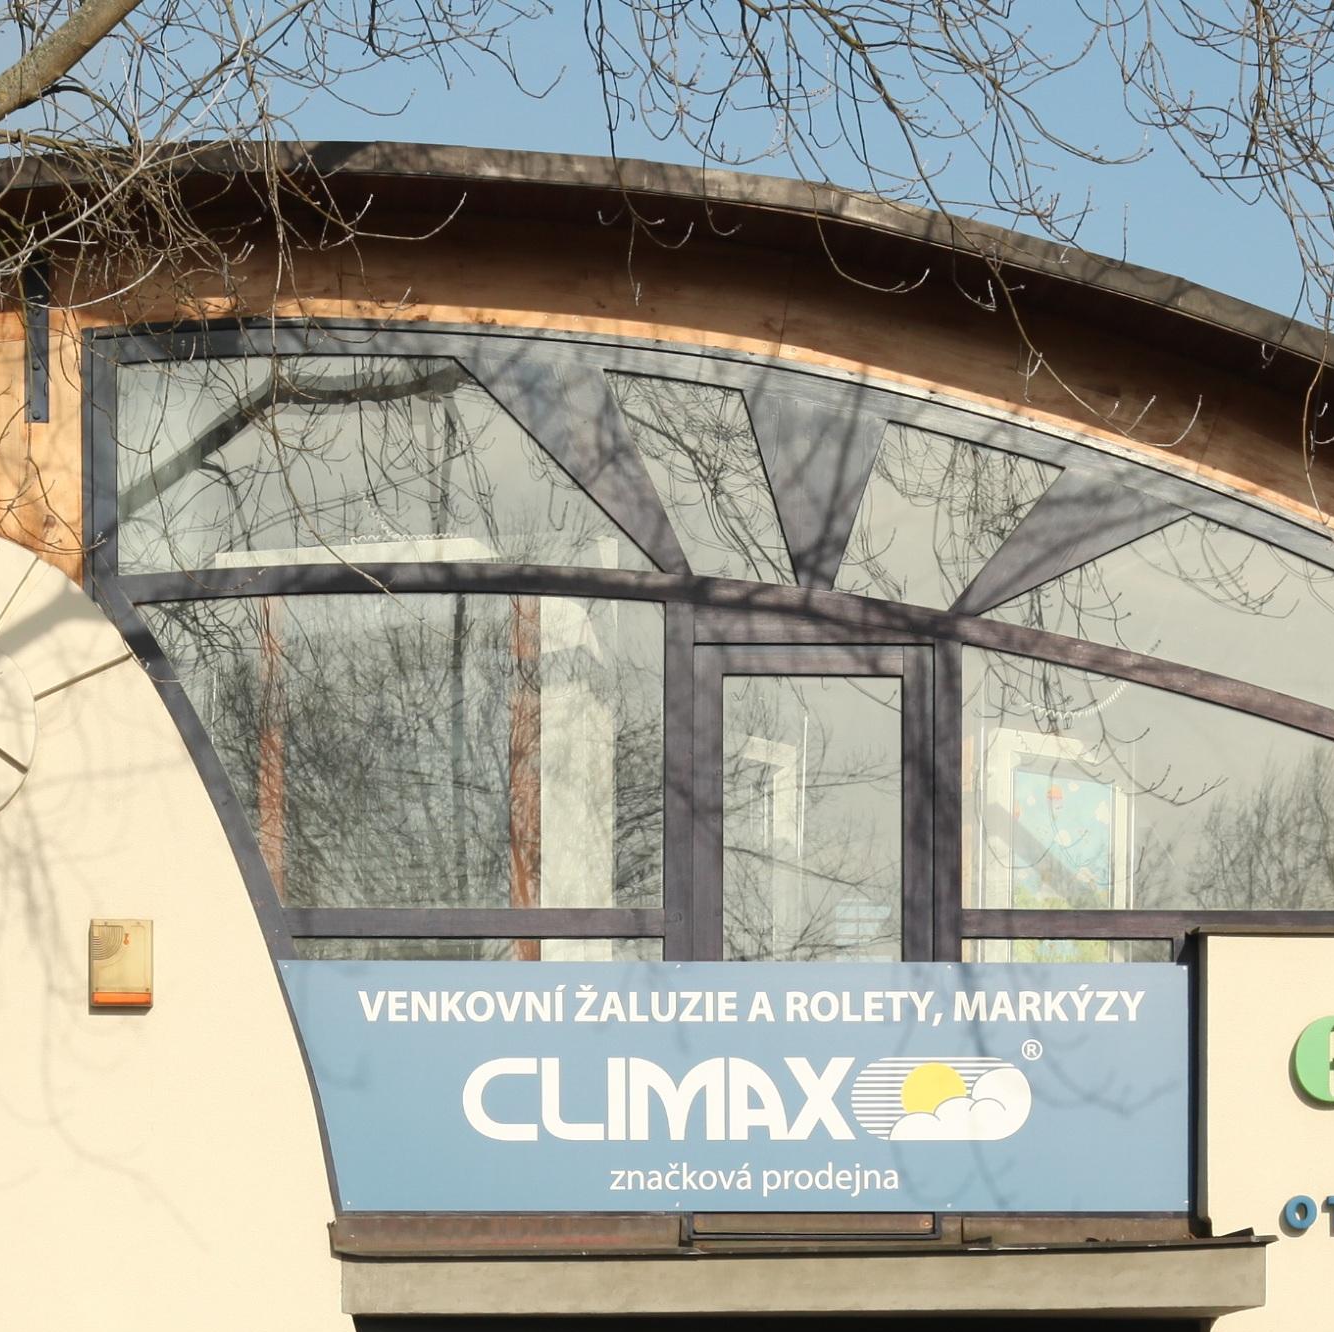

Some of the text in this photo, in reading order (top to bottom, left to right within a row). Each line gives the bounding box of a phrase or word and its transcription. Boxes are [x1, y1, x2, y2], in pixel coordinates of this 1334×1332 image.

[358, 983, 1146, 1027] VENKOVNÍ ŽALUZIE A ROLETY, MARKÝZY
[462, 1056, 857, 1141] CLIMAX
[610, 1161, 899, 1197] značková prodejna
